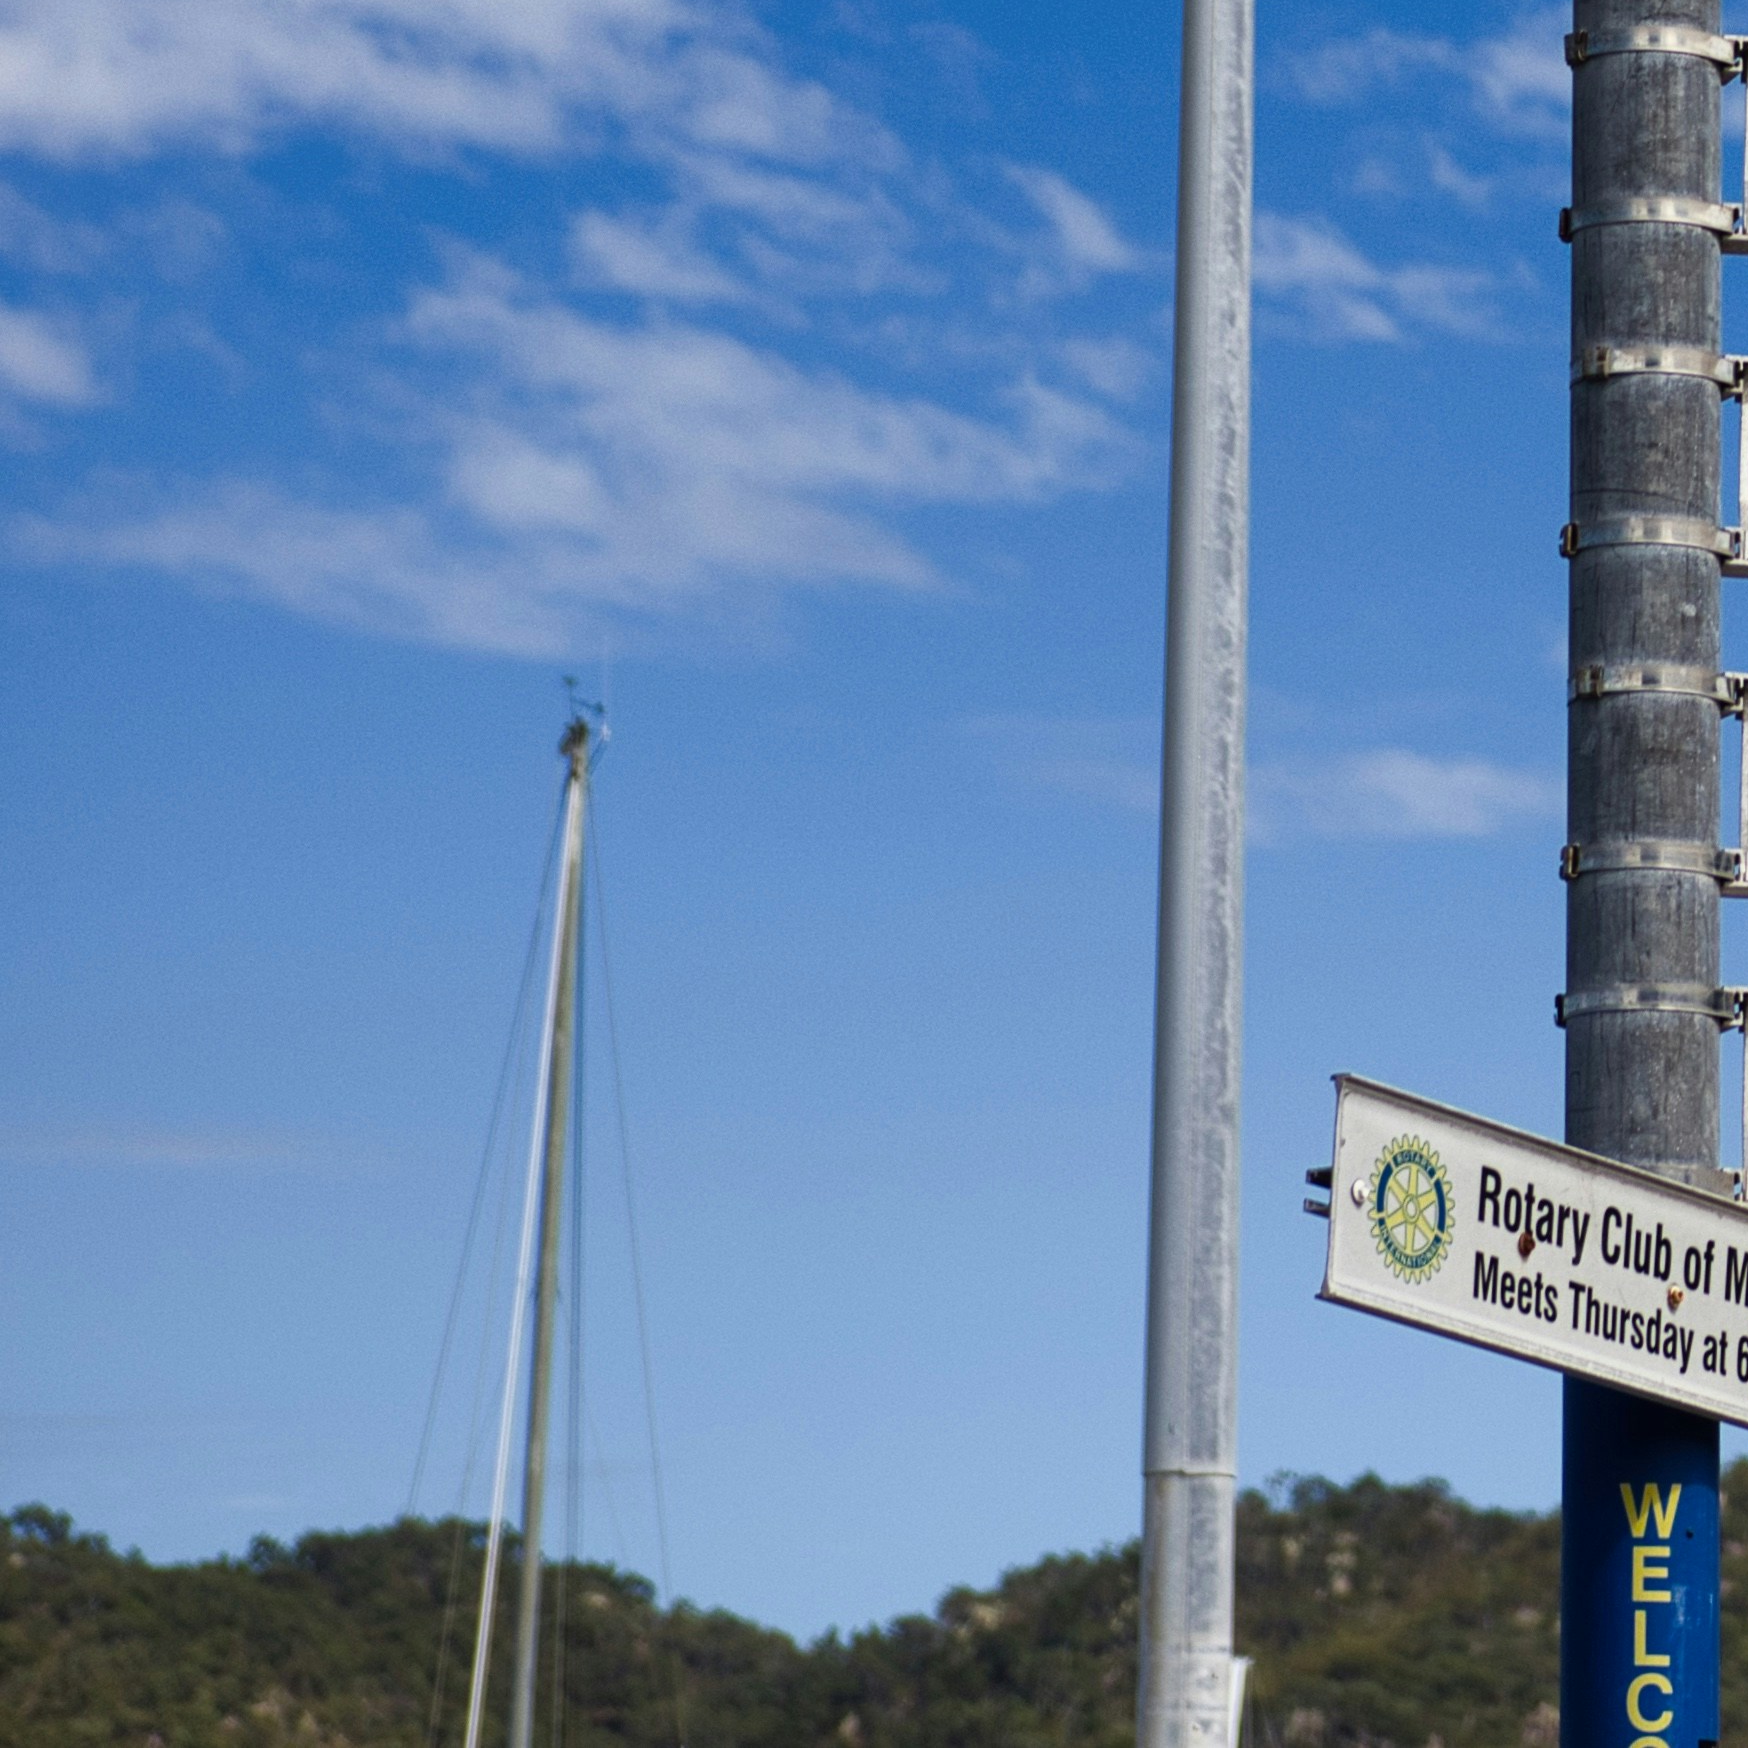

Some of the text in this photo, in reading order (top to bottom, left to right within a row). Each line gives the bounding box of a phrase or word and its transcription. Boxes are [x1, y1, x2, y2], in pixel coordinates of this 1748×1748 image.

[1478, 1165, 1590, 1266] Rotary
[1601, 1206, 1673, 1282] Club
[1684, 1239, 1715, 1295] of
[1473, 1251, 1558, 1323] Meets
[1568, 1280, 1694, 1375] Thursday
[1703, 1331, 1728, 1377] at
[1619, 1482, 1683, 1748] WELC
